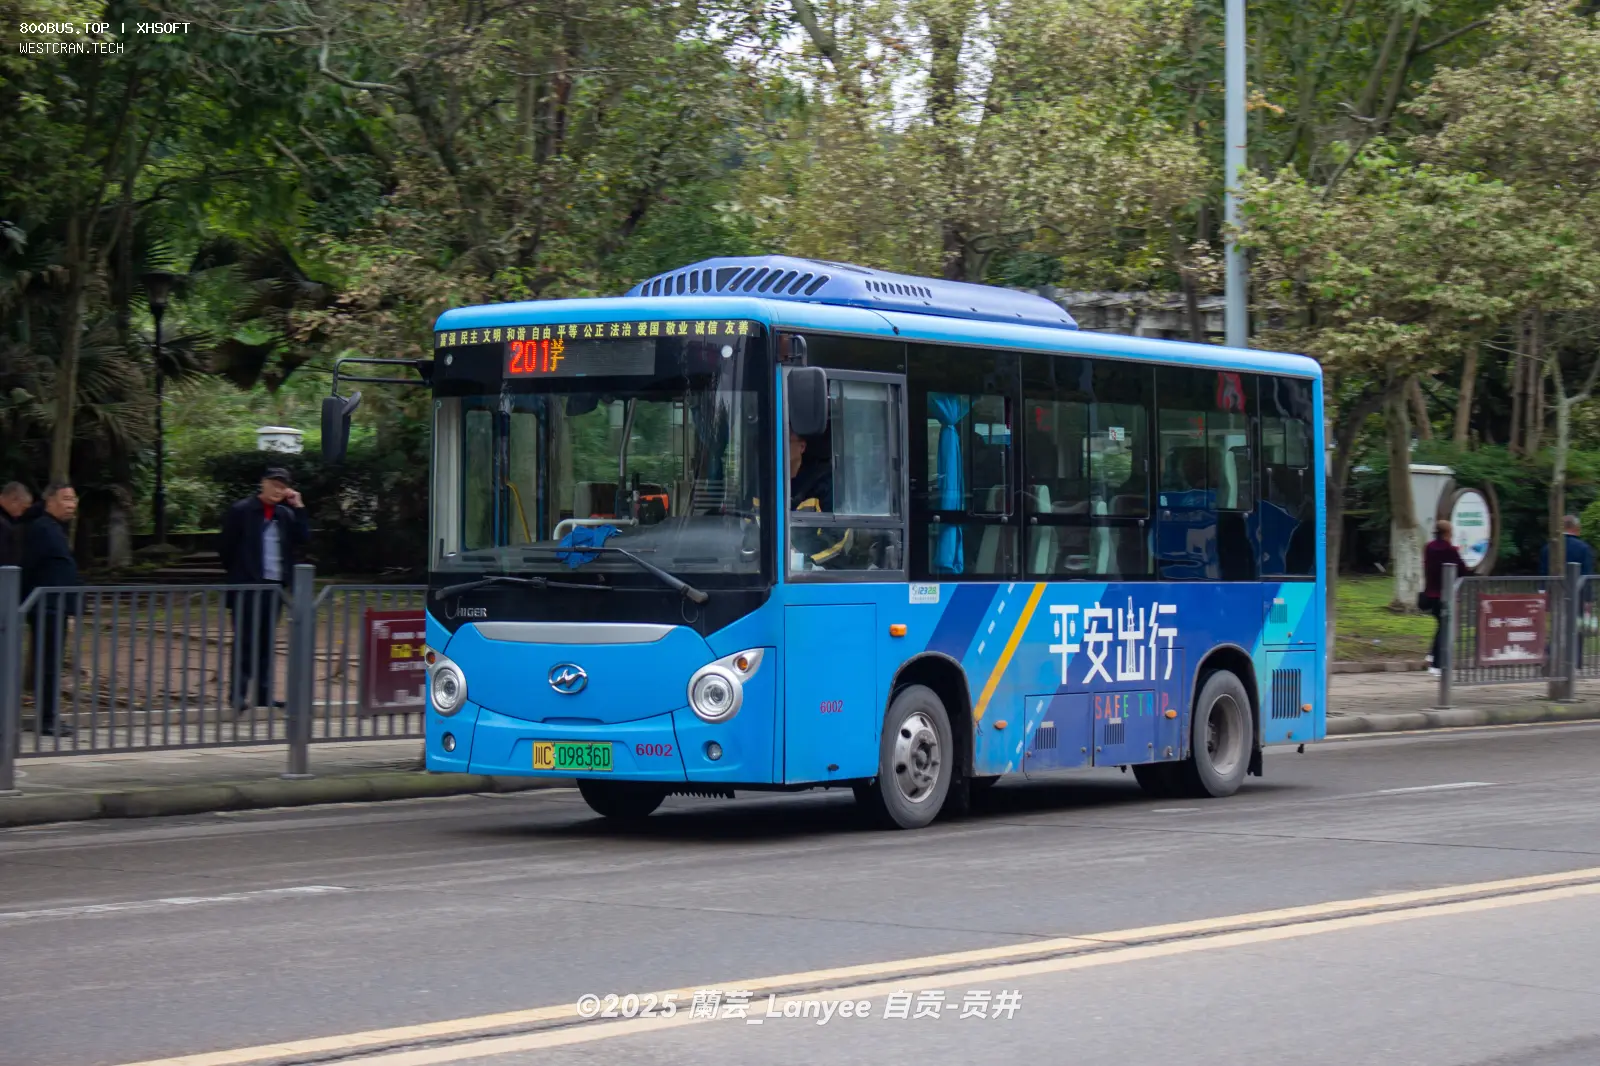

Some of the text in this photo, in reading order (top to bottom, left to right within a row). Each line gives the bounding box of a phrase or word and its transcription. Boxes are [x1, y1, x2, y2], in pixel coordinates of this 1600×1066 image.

[440, 320, 748, 347] 富强 民主 文明 和谐 自由 平等 公正 法治 爱国 敬业 诚信 友善
[456, 607, 487, 617] HIGER
[1049, 596, 1177, 685] 平安出行
[819, 700, 844, 714] 6002
[1095, 692, 1169, 720] SAFE TRIP
[635, 743, 673, 757] 6002
